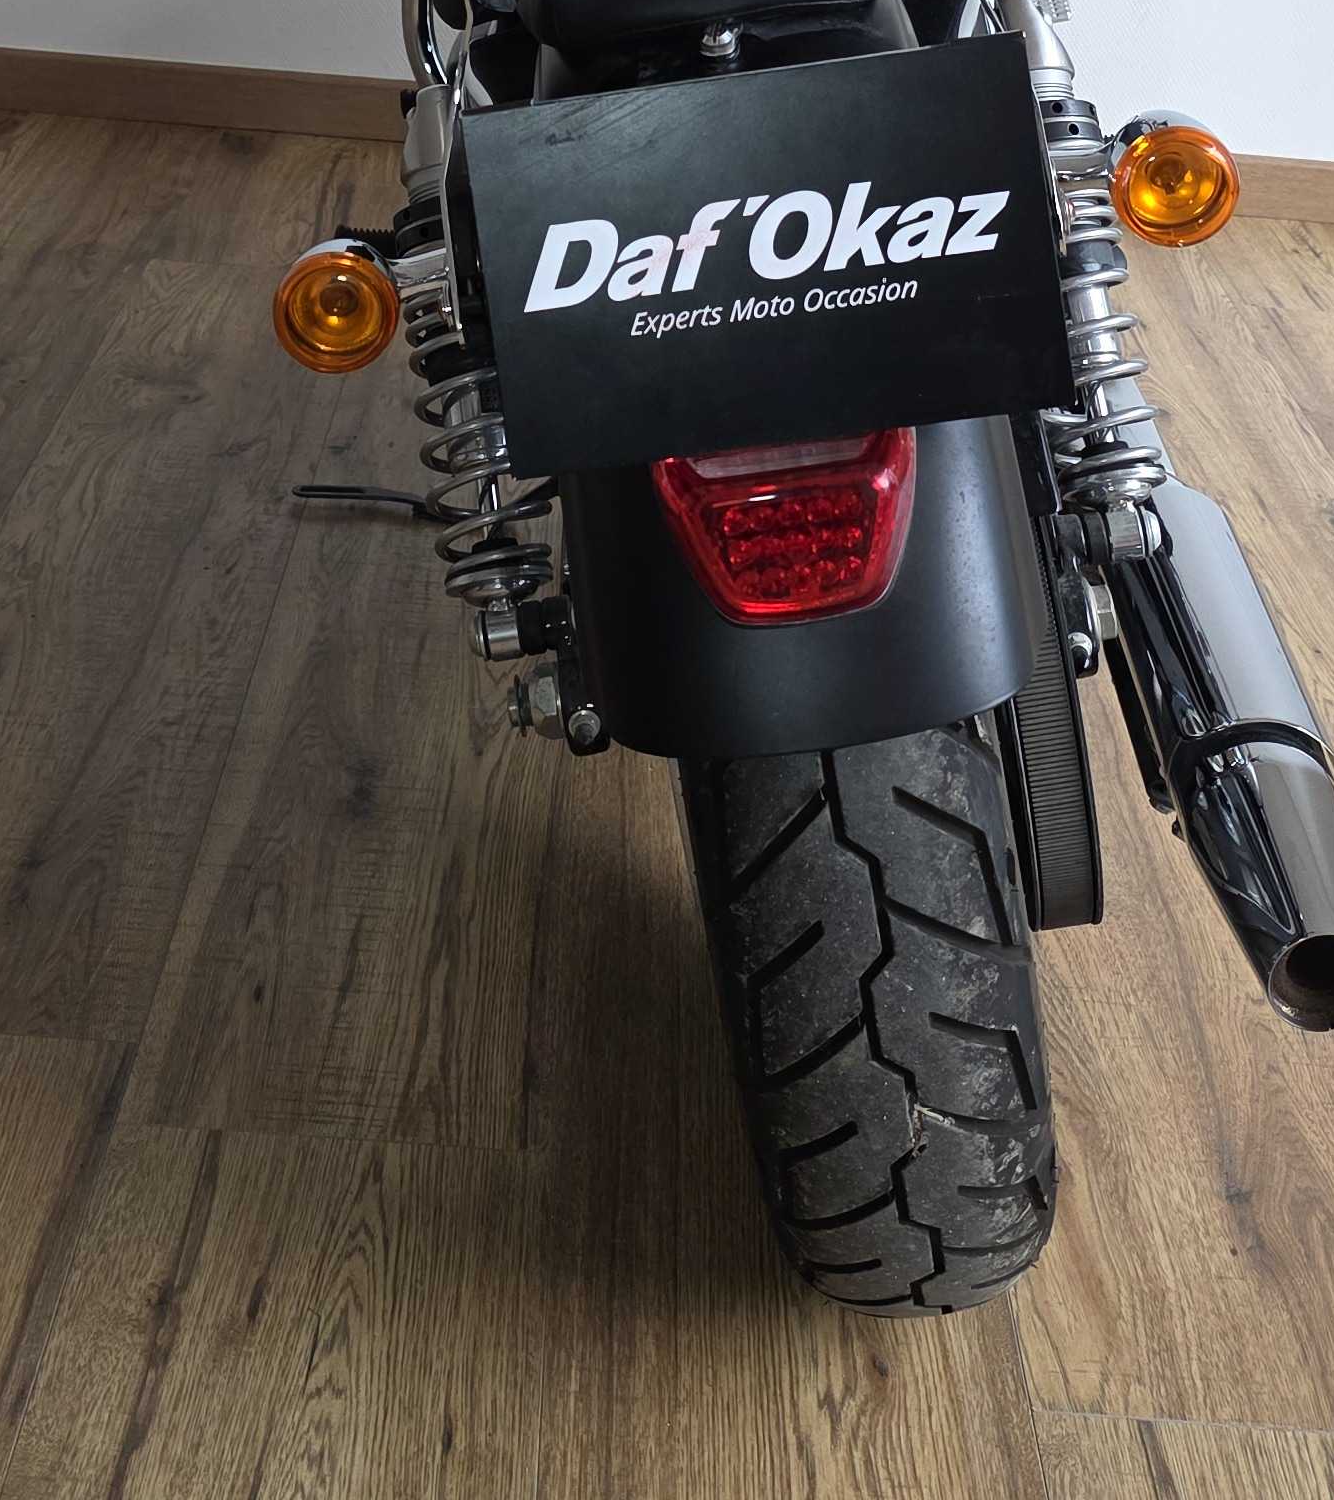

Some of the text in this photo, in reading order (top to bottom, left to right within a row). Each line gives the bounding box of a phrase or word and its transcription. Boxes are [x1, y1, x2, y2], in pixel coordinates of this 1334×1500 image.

[630, 277, 919, 339] Experts Moto Occasion
